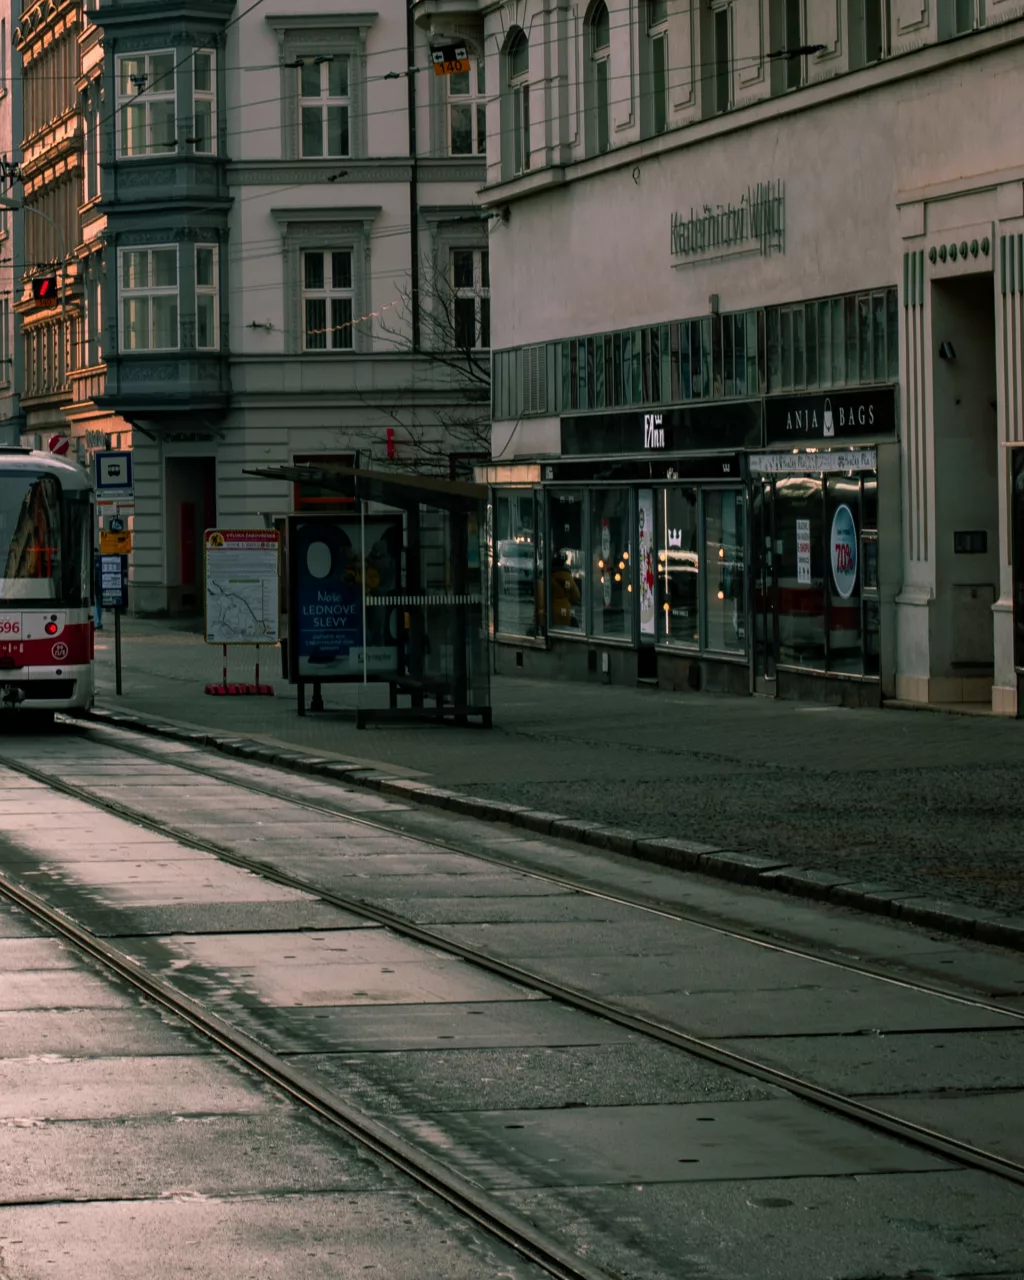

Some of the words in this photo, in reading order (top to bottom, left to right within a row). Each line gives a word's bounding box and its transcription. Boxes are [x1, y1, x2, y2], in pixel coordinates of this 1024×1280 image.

[439, 61, 462, 73] 140
[786, 408, 818, 432] ANJA
[839, 405, 875, 426] BAGS
[835, 544, 854, 571] 70%
[302, 604, 357, 616] LEDNOVÉ
[313, 616, 348, 628] SLEVY
